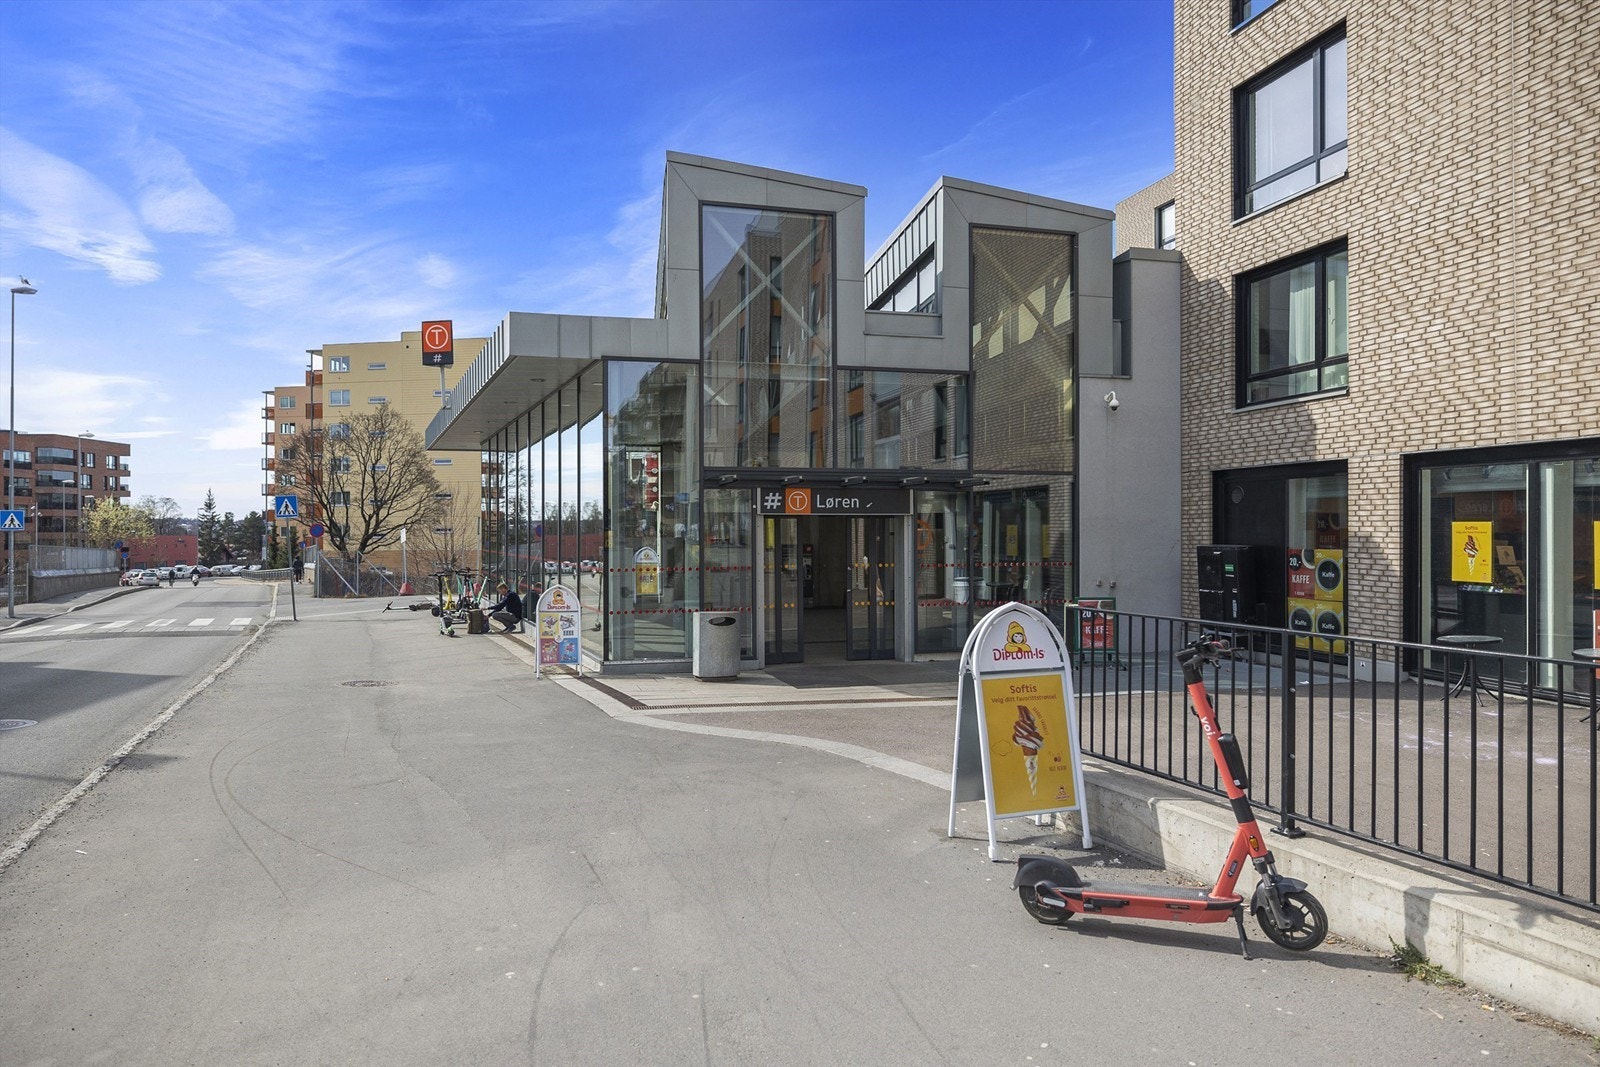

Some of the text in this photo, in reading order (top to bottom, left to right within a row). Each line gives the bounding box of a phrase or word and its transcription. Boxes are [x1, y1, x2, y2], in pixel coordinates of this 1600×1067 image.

[430, 330, 442, 344] T
[816, 494, 860, 509] Løren
[1289, 557, 1302, 568] 20,-
[1291, 574, 1310, 584] KAFFE
[1321, 622, 1335, 630] Kaffe
[1009, 684, 1038, 694] Softis
[991, 696, 1004, 704] Velg
[1004, 695, 1015, 703] ditt
